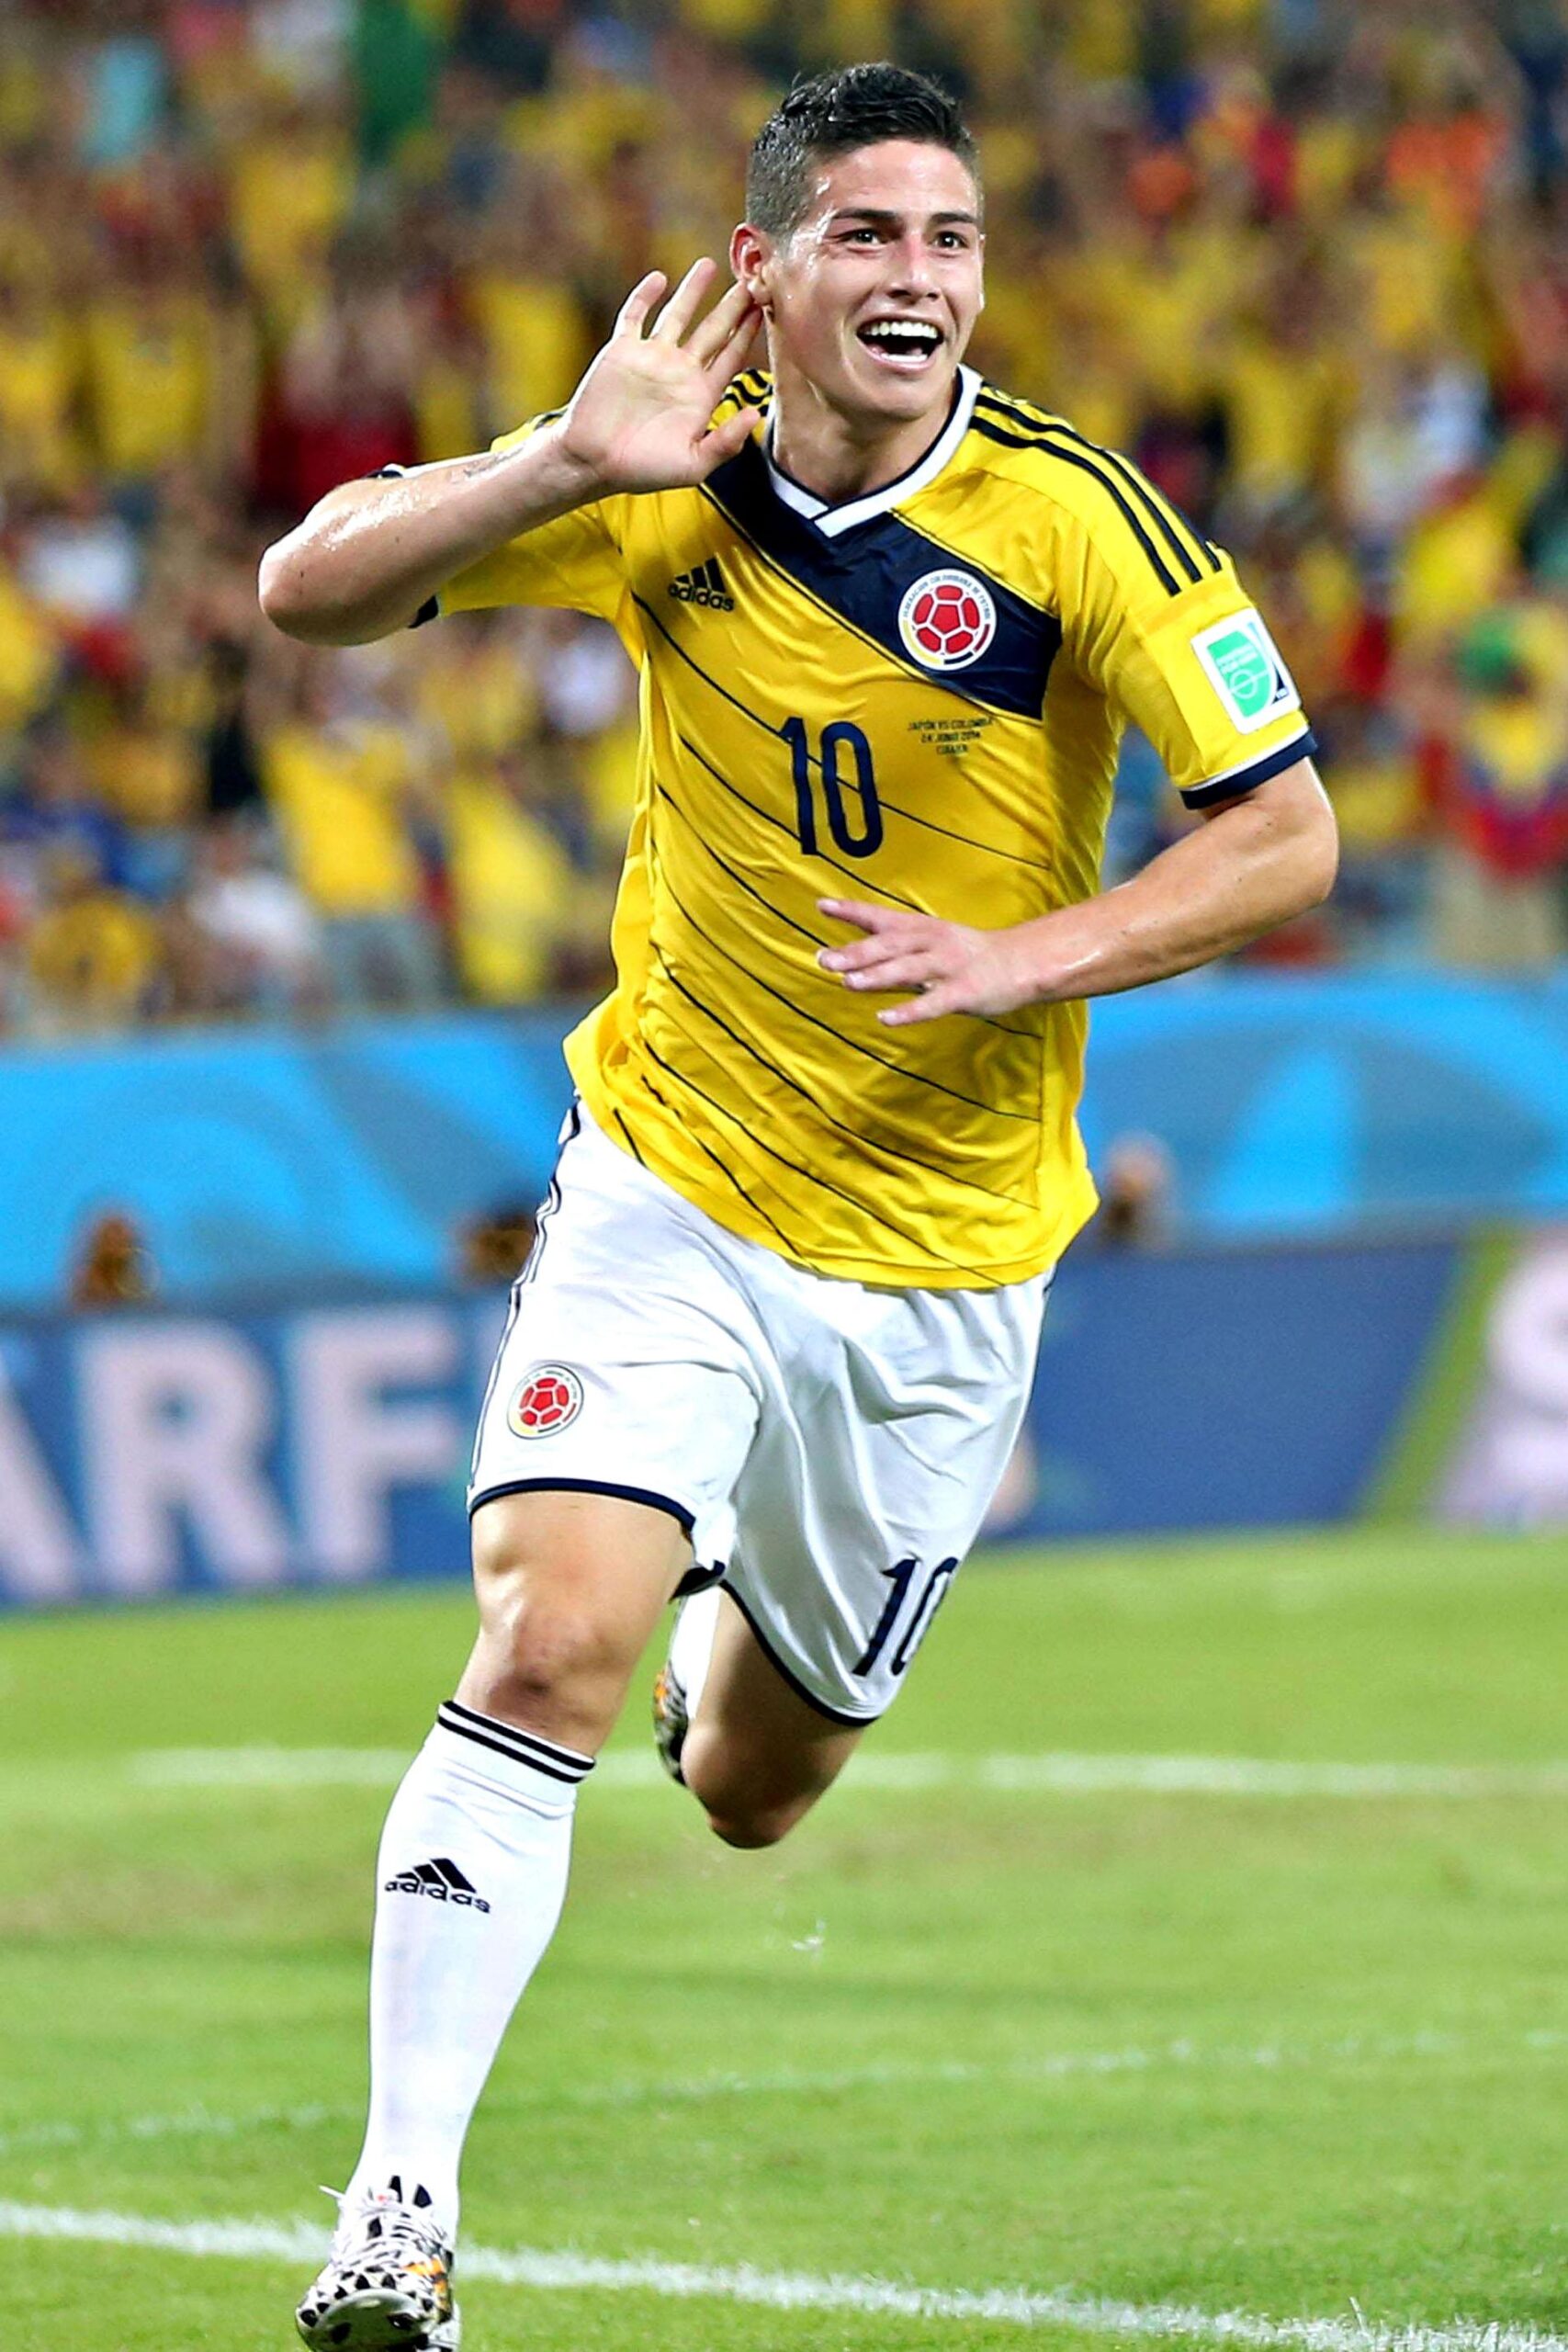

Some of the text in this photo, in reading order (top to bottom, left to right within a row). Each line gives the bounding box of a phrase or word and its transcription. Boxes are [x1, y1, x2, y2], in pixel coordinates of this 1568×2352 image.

[668, 582, 734, 612] adidas
[780, 716, 884, 858] 10
[852, 1556, 958, 1677] 10
[384, 1877, 491, 1914] adidas
